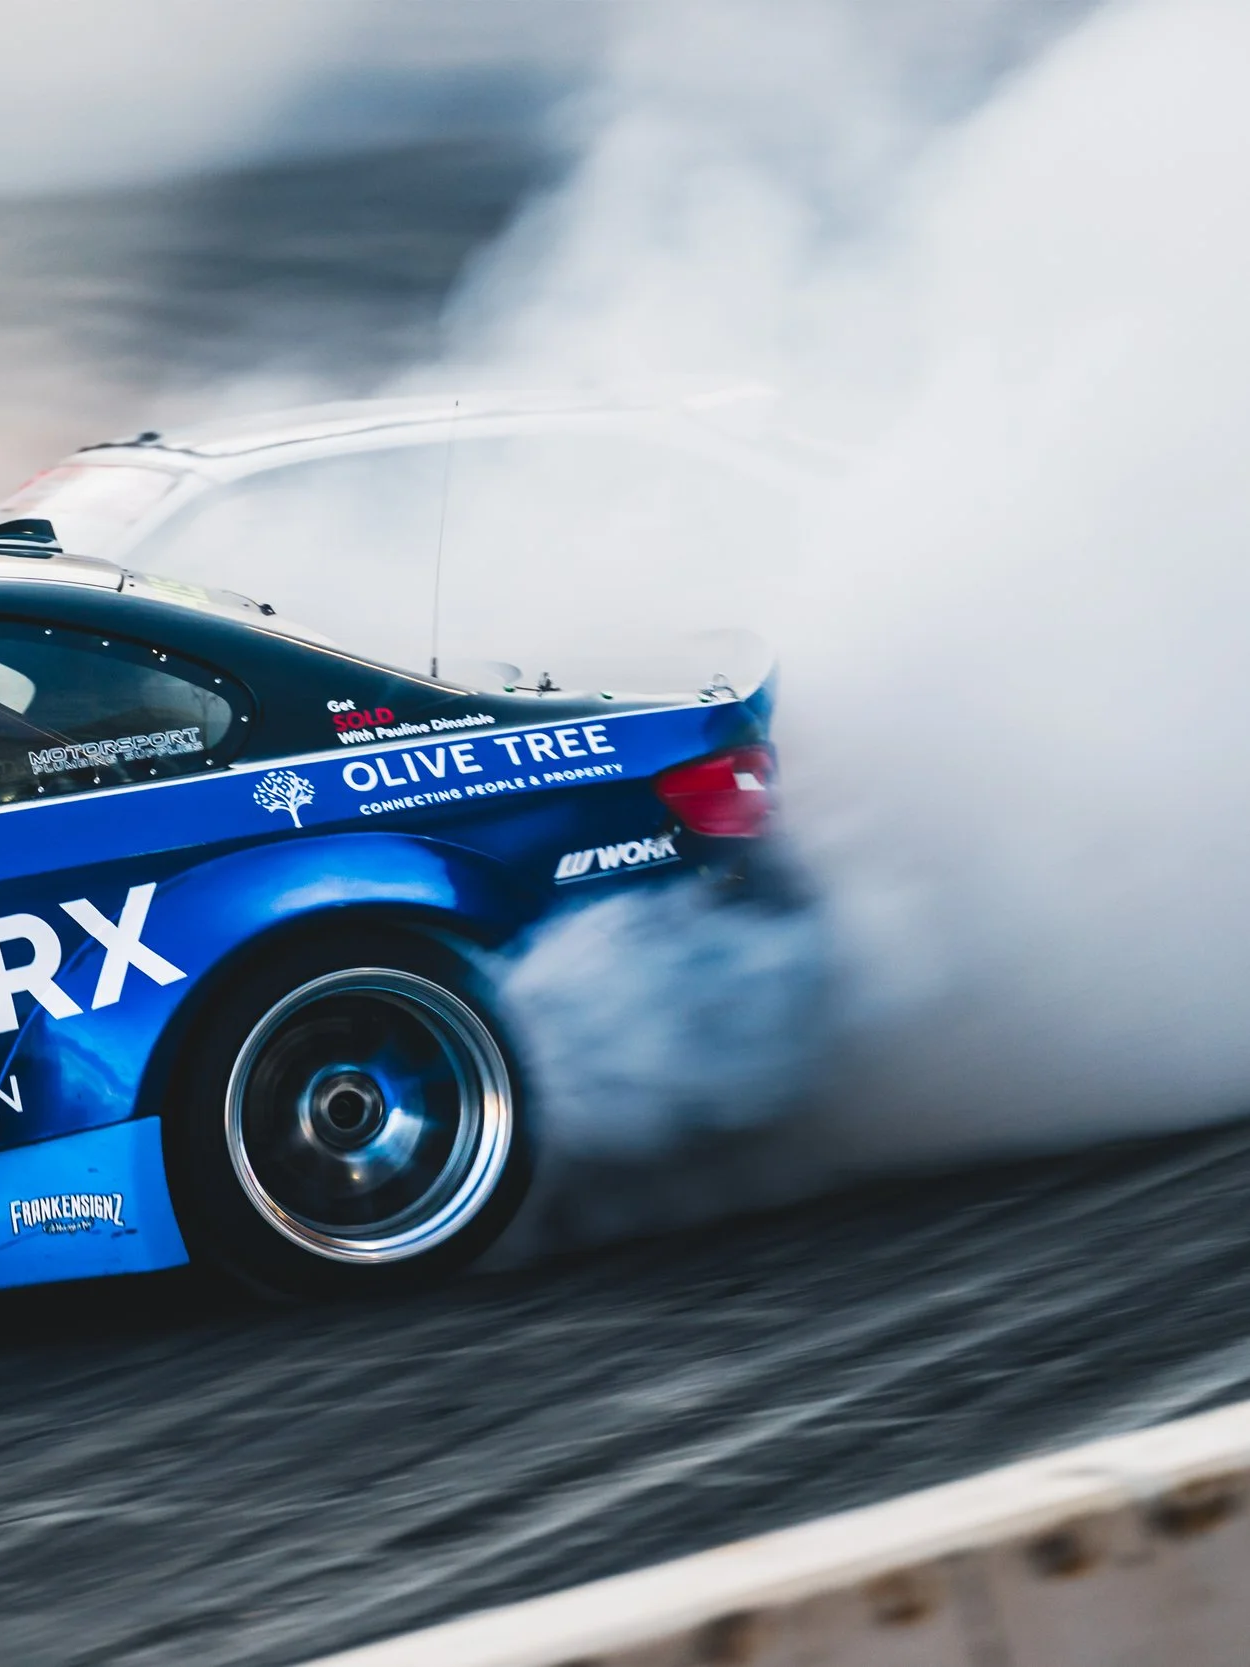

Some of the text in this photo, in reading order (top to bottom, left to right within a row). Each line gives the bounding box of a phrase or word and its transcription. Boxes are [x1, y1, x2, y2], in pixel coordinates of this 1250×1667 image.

[327, 699, 357, 713] Get
[333, 707, 395, 732] SOLD
[27, 726, 200, 766] MOTORSPORT
[337, 713, 496, 745] With Pauline Dinsdale
[31, 740, 205, 776] PLUMBING SUPPLIES
[342, 724, 617, 792] OLIVE TREE
[359, 763, 625, 816] CONNECTING PEOPLE & PROPERTY
[10, 1192, 125, 1236] FRANKENSIGNZ
